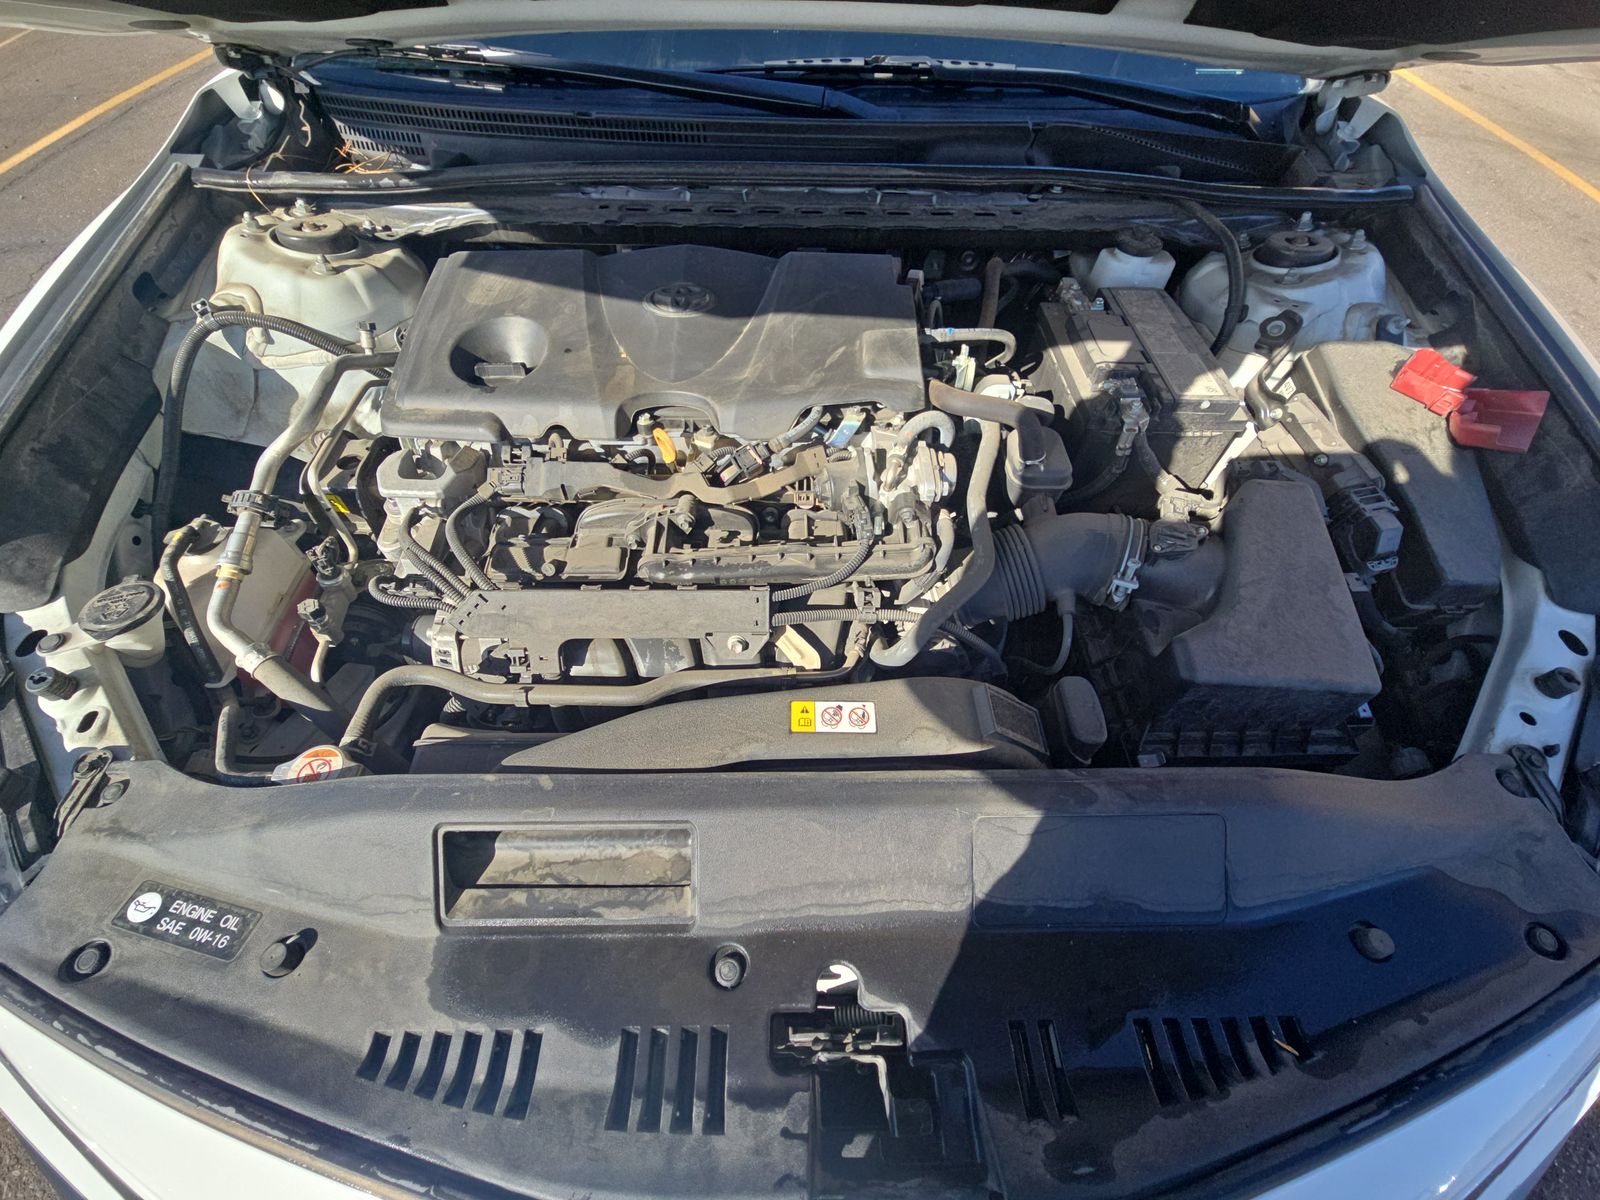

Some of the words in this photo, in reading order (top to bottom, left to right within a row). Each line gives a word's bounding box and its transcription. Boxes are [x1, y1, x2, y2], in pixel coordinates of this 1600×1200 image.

[168, 900, 217, 923] ENGINE
[219, 914, 240, 931] OIL
[156, 917, 186, 936] SAE
[188, 926, 230, 949] 0W-16
